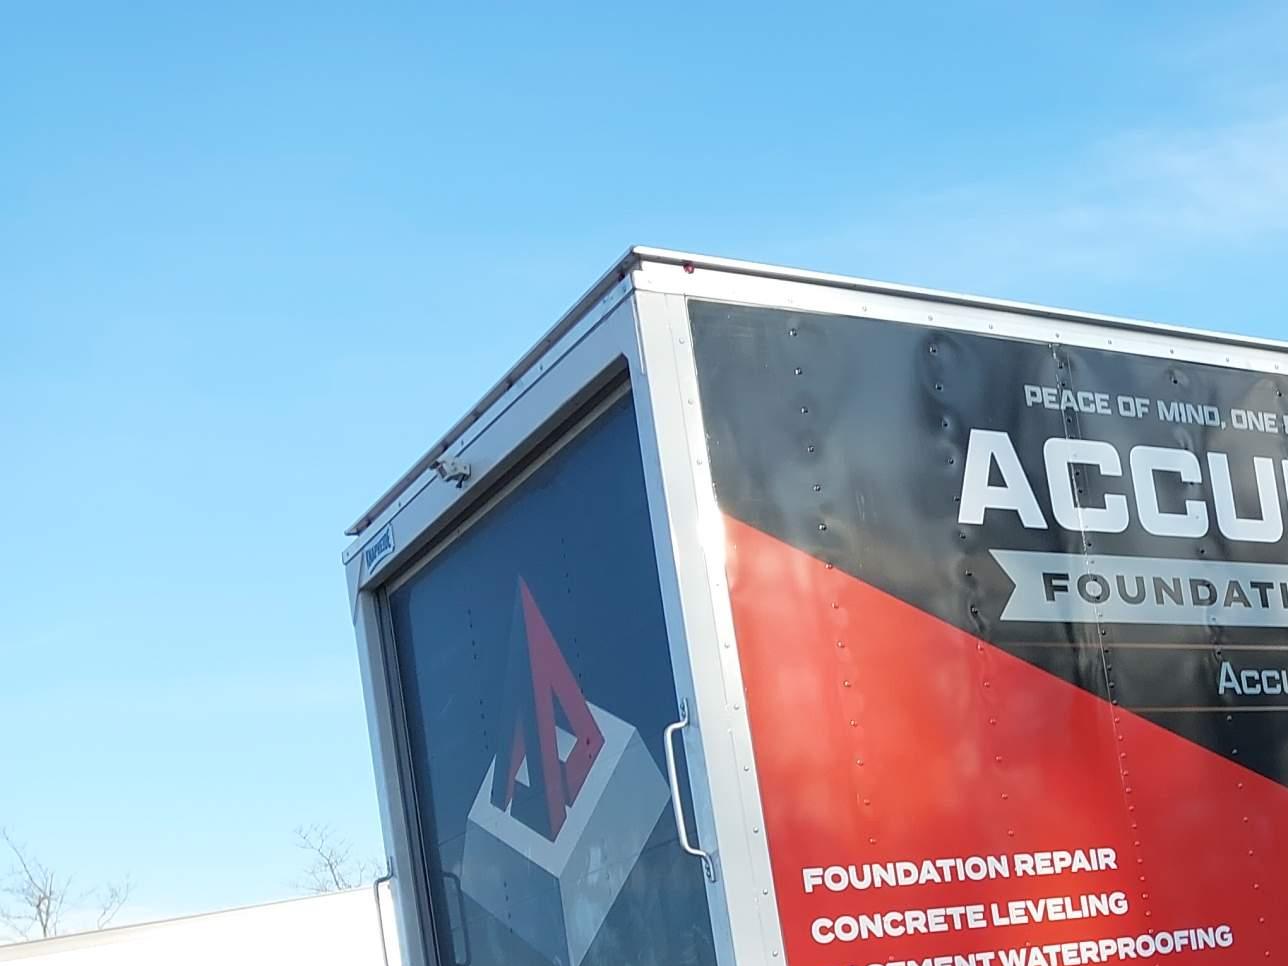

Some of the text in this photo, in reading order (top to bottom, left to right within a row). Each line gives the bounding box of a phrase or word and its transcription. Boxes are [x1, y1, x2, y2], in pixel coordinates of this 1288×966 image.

[1024, 384, 1112, 415] PEACE
[1117, 395, 1150, 418] OF
[1157, 400, 1226, 430] MIND,
[1231, 408, 1278, 433] ONE
[802, 847, 1118, 893] FOUNDATION REPAIR
[811, 892, 1129, 945] CONCRETE LEVELING
